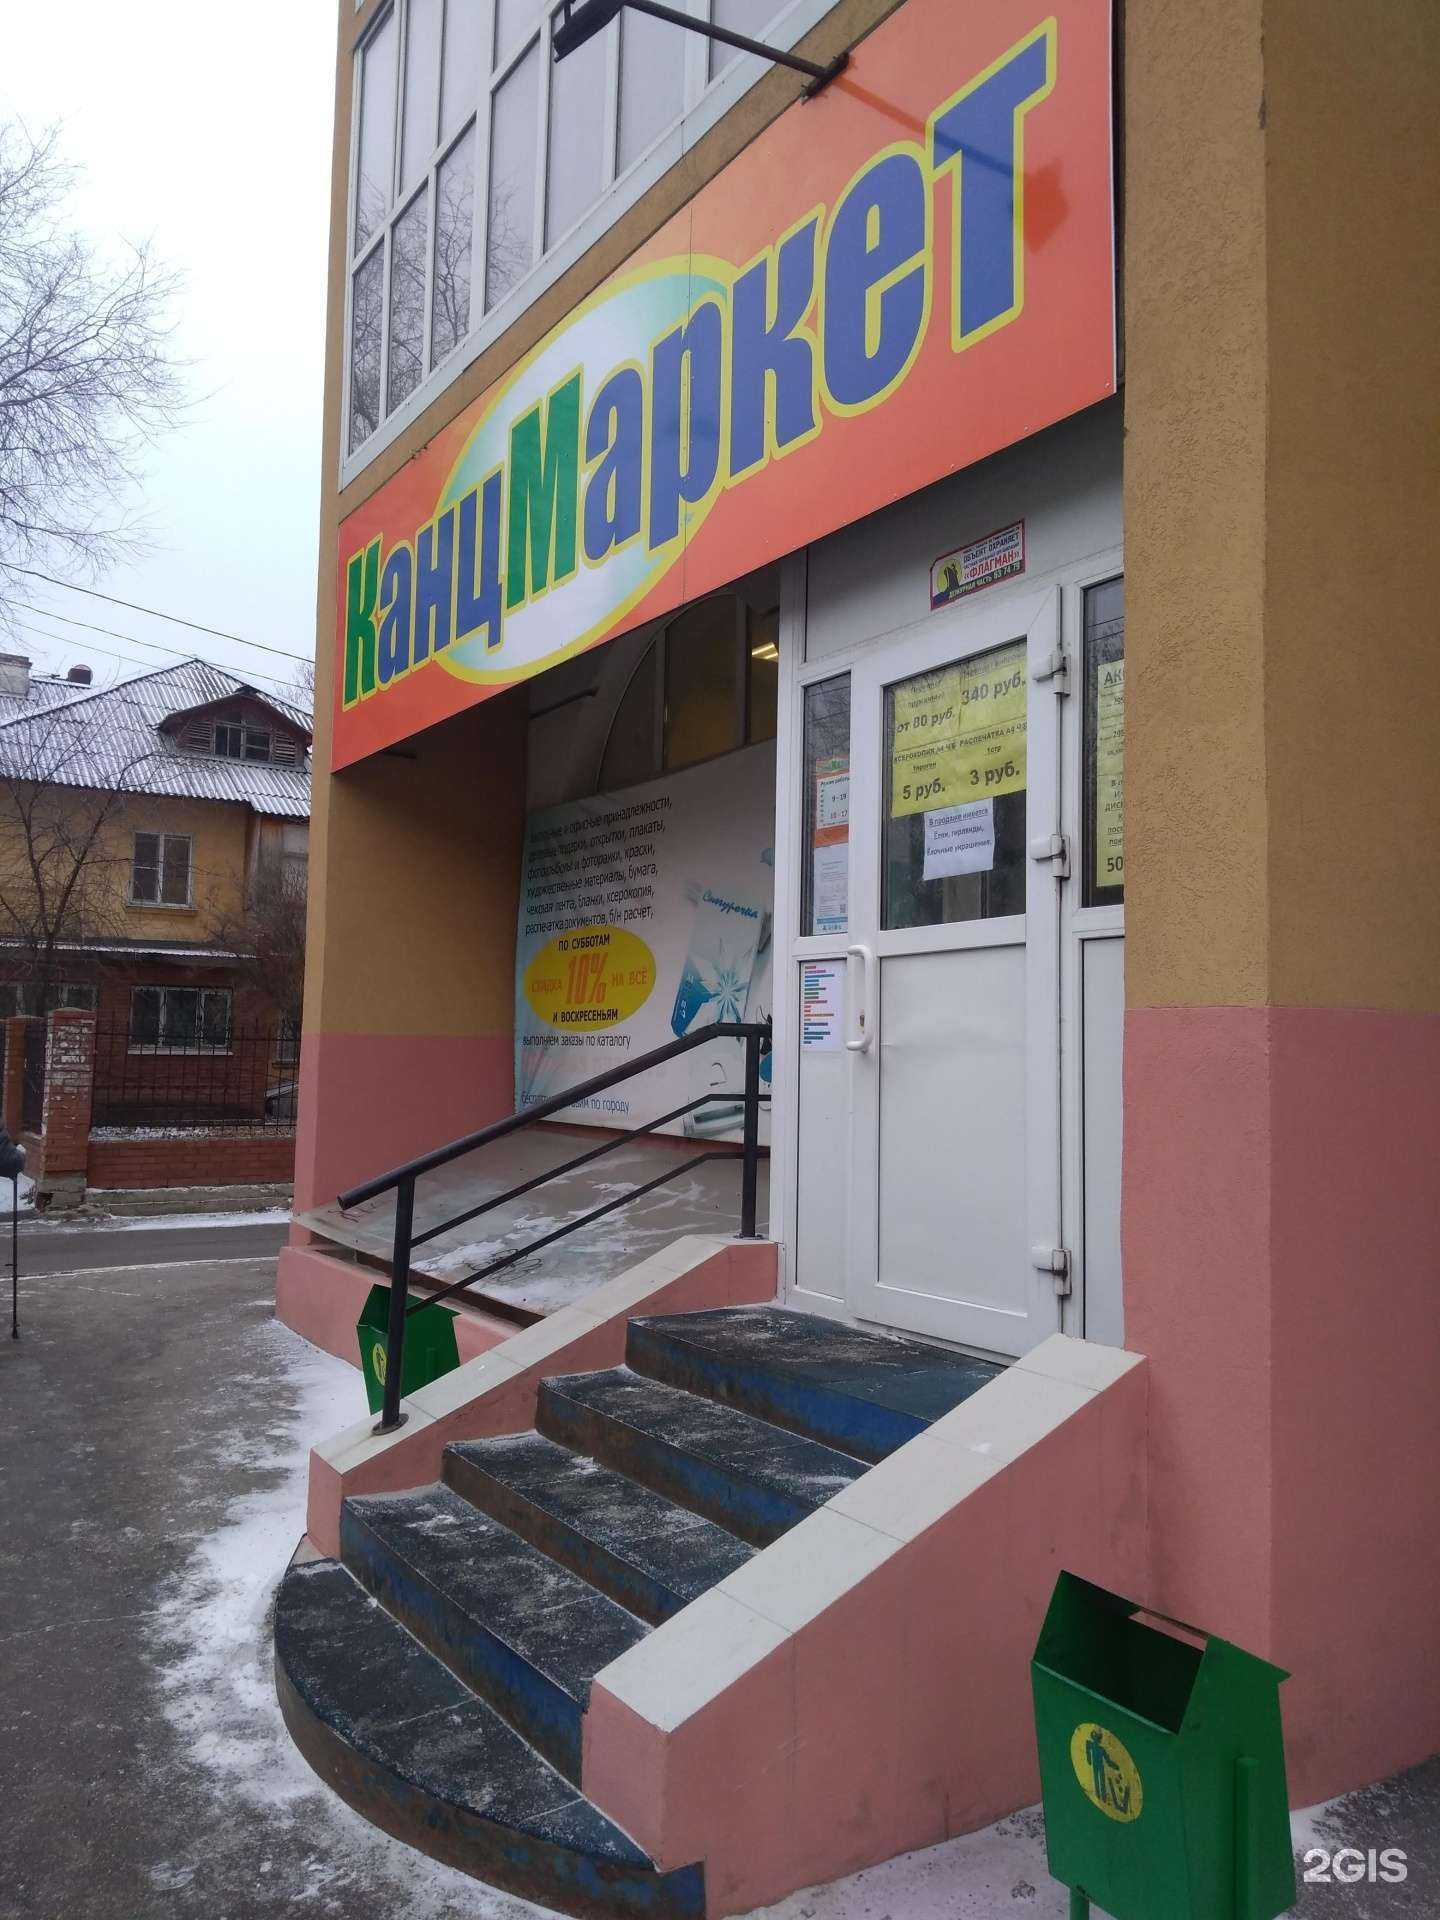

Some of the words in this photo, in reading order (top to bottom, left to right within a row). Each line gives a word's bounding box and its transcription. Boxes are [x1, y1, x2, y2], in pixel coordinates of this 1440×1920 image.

[342, 16, 1057, 711] КанцМаркет
[989, 533, 1019, 552] ОХРАНЯЕТ
[961, 684, 988, 705] 340
[994, 670, 1026, 699] руб.
[1104, 668, 1125, 686] АК
[897, 721, 910, 733] от
[913, 714, 927, 728] 80
[931, 707, 956, 727] руб.
[959, 730, 1004, 746] РАСПЕЧАТКА
[970, 769, 980, 785] 3
[985, 761, 1021, 786] руб.
[902, 784, 911, 799] 5
[915, 778, 946, 801] руб.
[603, 796, 672, 825] принадлежности,
[558, 940, 568, 952] ПО
[572, 934, 610, 950] СУББОТАМ
[566, 952, 608, 1005] 10%
[553, 1011, 558, 1023] И
[561, 1008, 618, 1023] ВОСКРЕСЕНЬЯМ
[586, 1036, 596, 1046] по
[597, 1035, 631, 1050] каталогу
